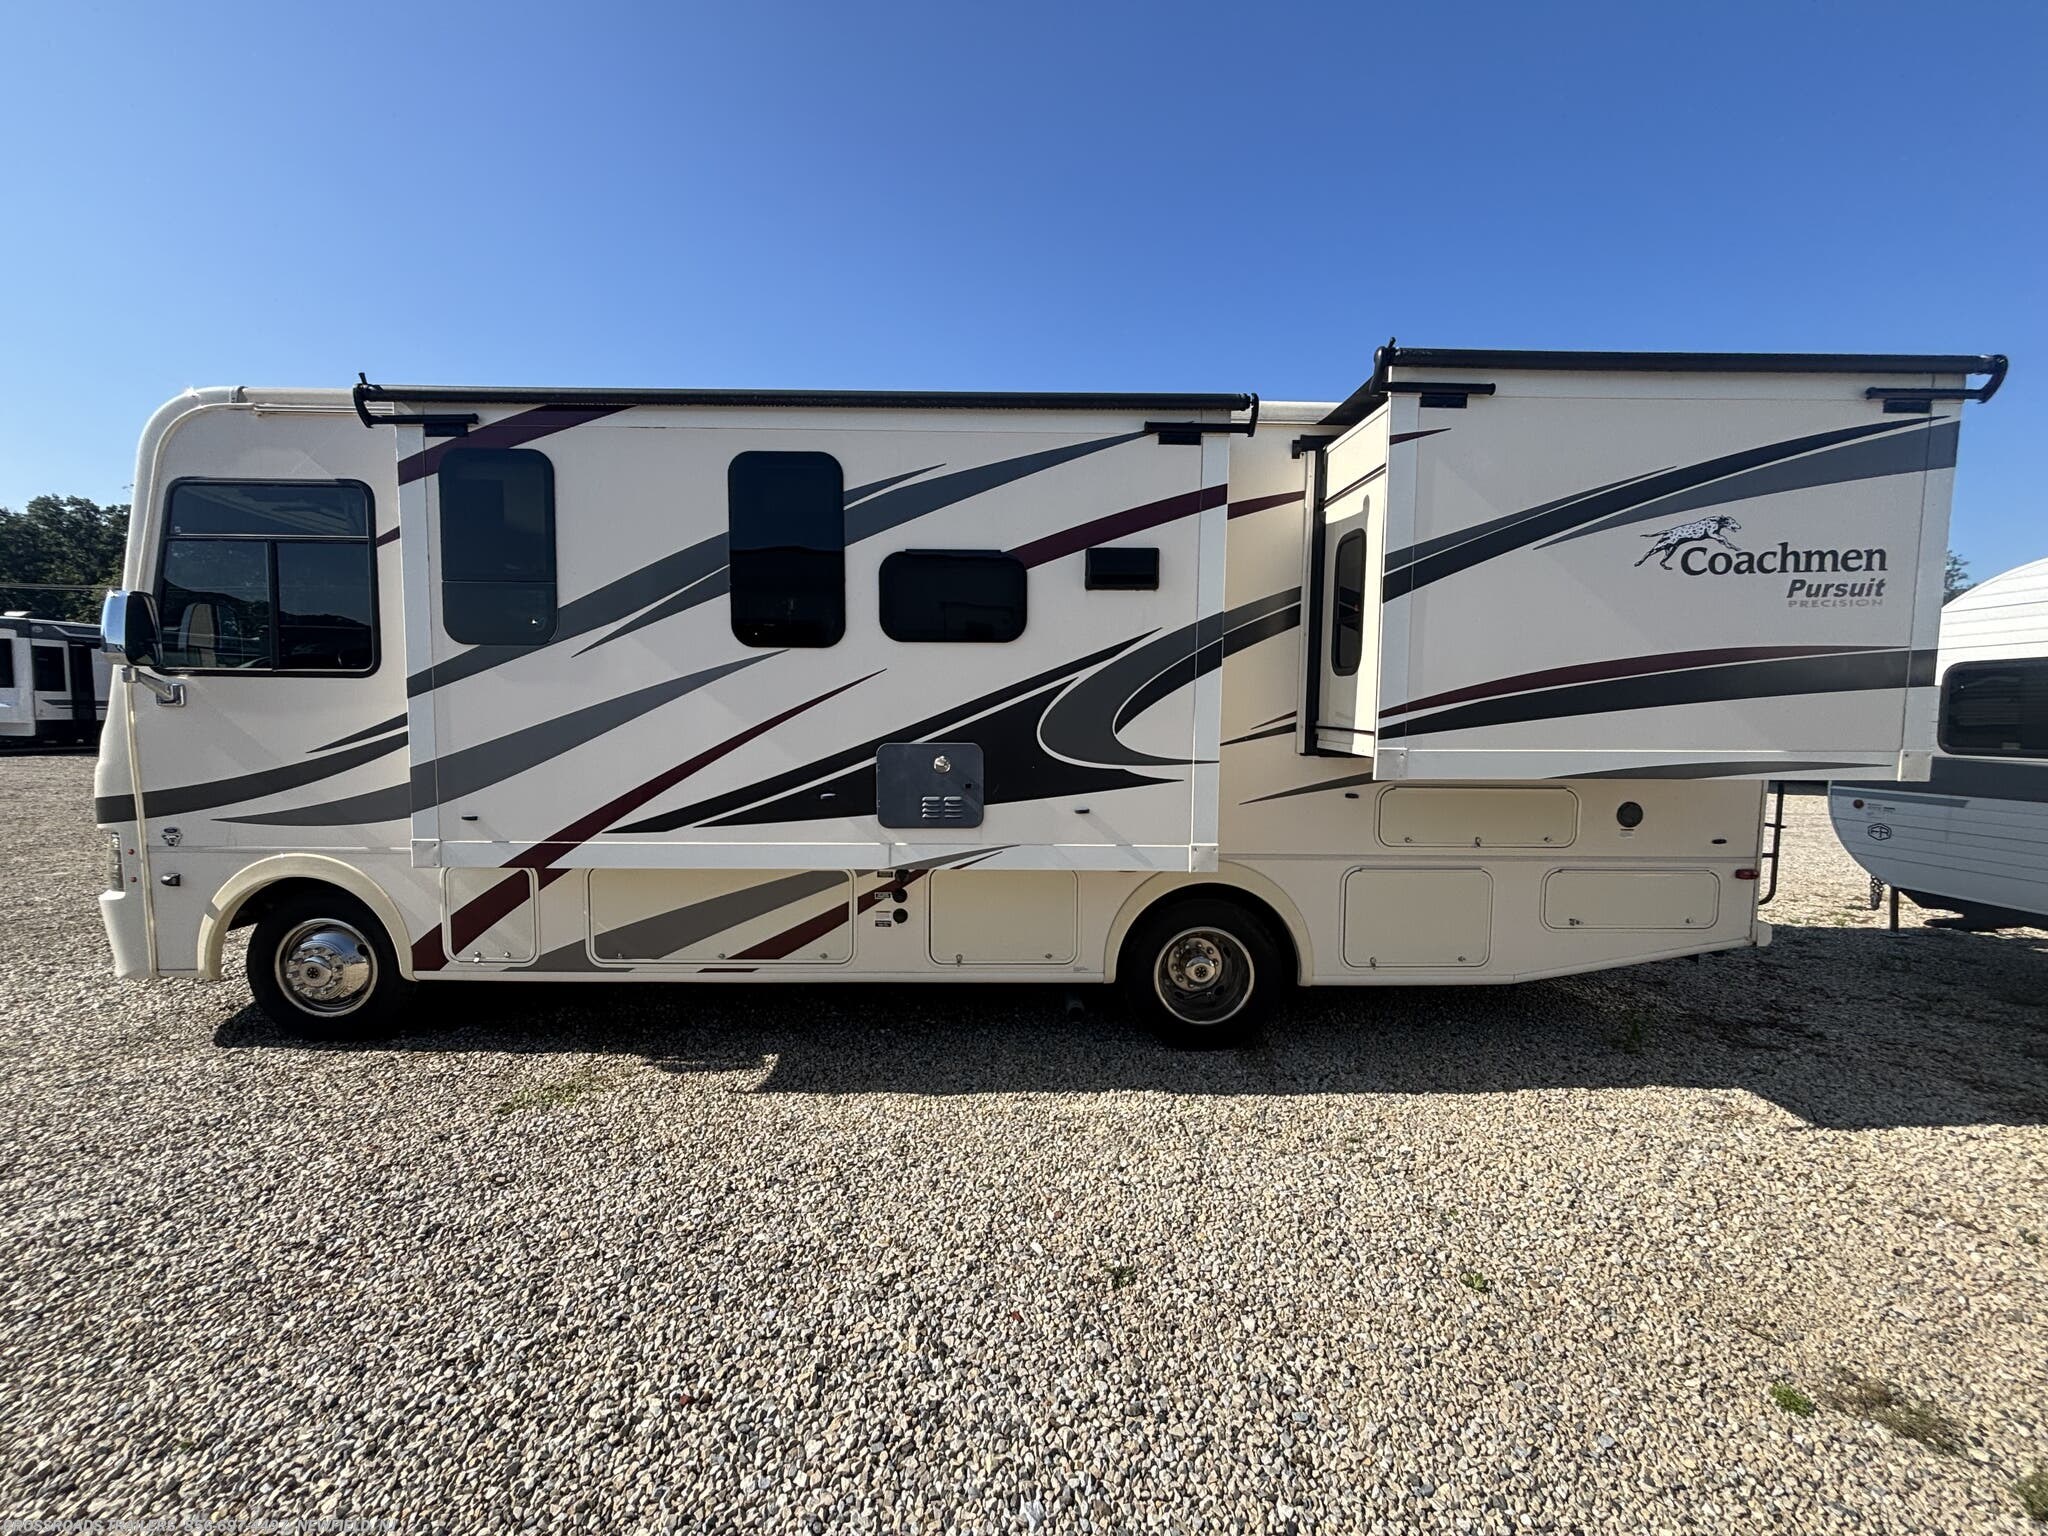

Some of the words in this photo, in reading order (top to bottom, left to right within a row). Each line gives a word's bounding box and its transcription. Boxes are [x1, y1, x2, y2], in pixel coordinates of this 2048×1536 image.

[1680, 541, 1888, 576] Coachmen
[1786, 577, 1886, 598] Pursuit
[1787, 599, 1884, 608] PRECISION
